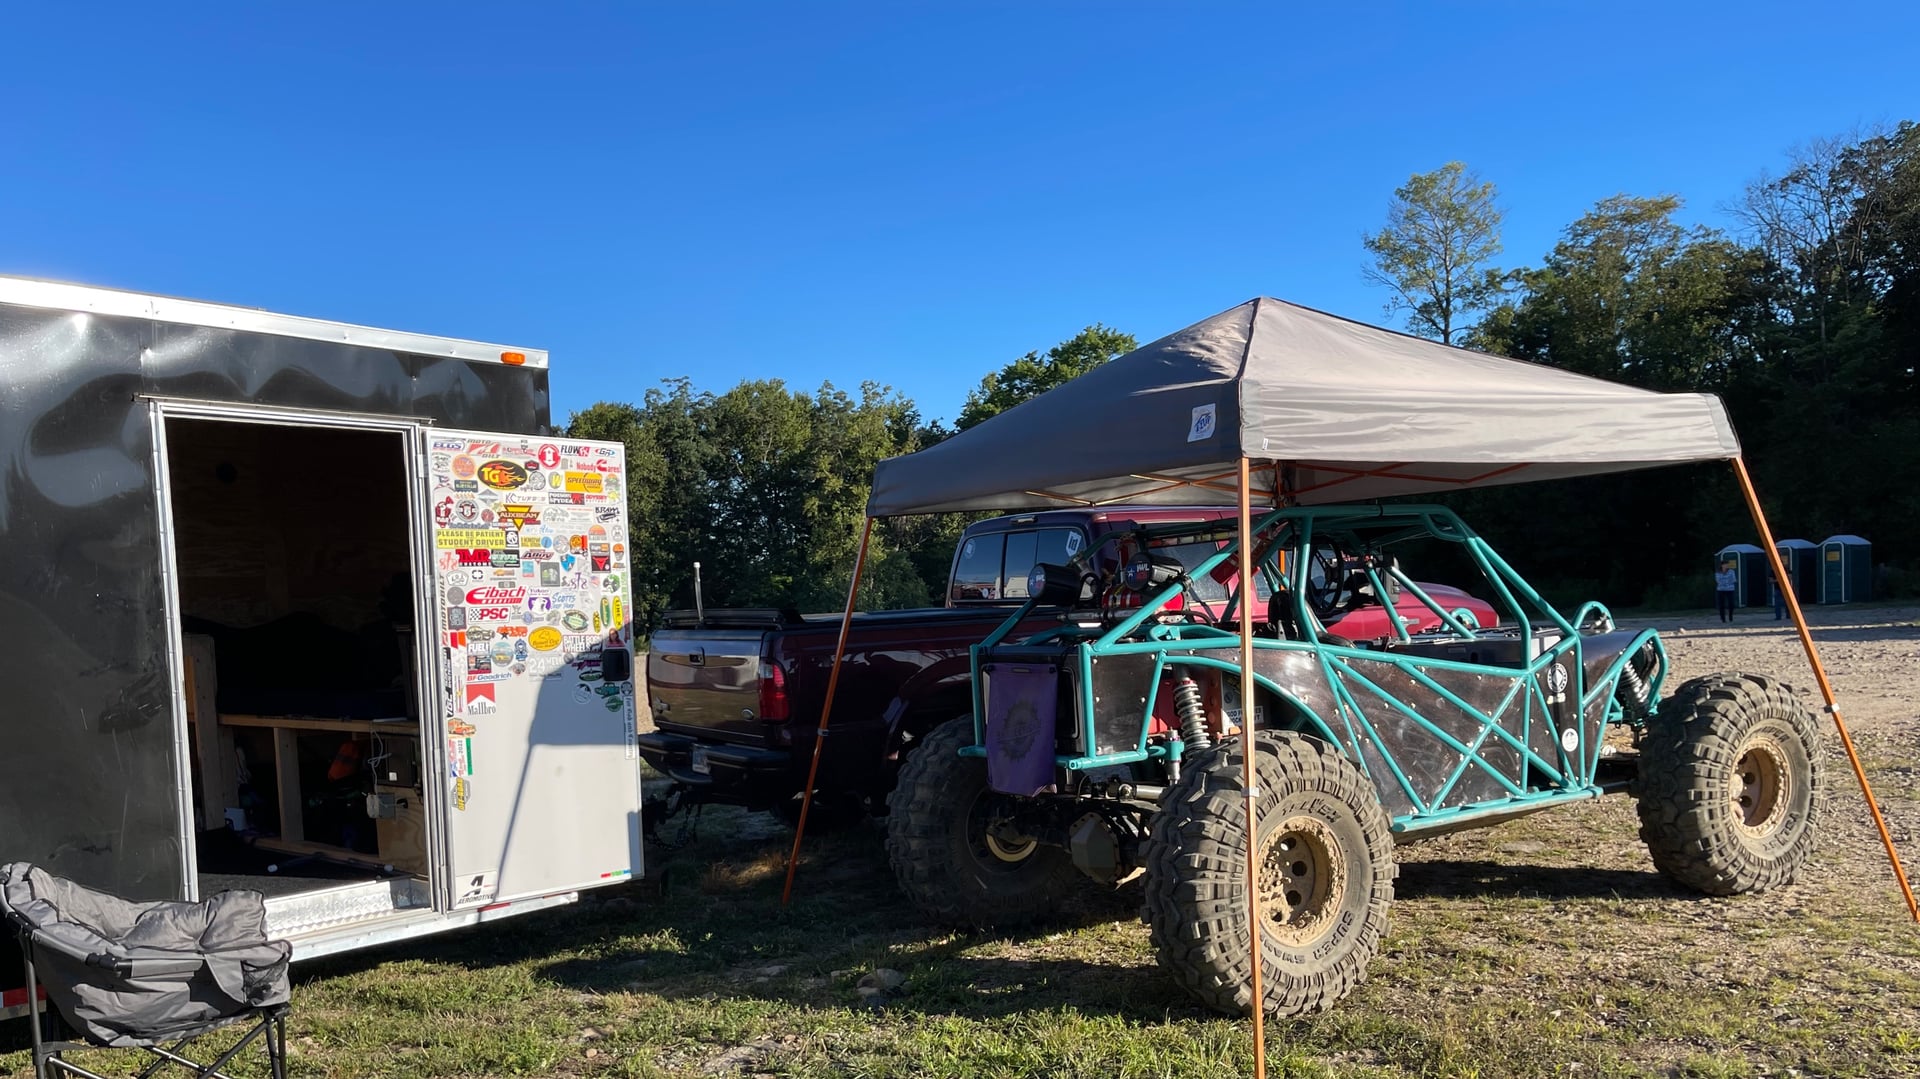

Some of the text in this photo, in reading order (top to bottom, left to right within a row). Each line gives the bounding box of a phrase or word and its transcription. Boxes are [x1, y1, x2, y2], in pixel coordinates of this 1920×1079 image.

[481, 468, 500, 483] TG
[466, 586, 526, 605] Eibach
[480, 607, 509, 620] PSC
[564, 635, 585, 643] BATTLE
[564, 642, 591, 652] WHEELS
[468, 702, 496, 715] Mallbro
[458, 893, 494, 905] AEROMOTIVE
[1312, 910, 1353, 960] SUPER
